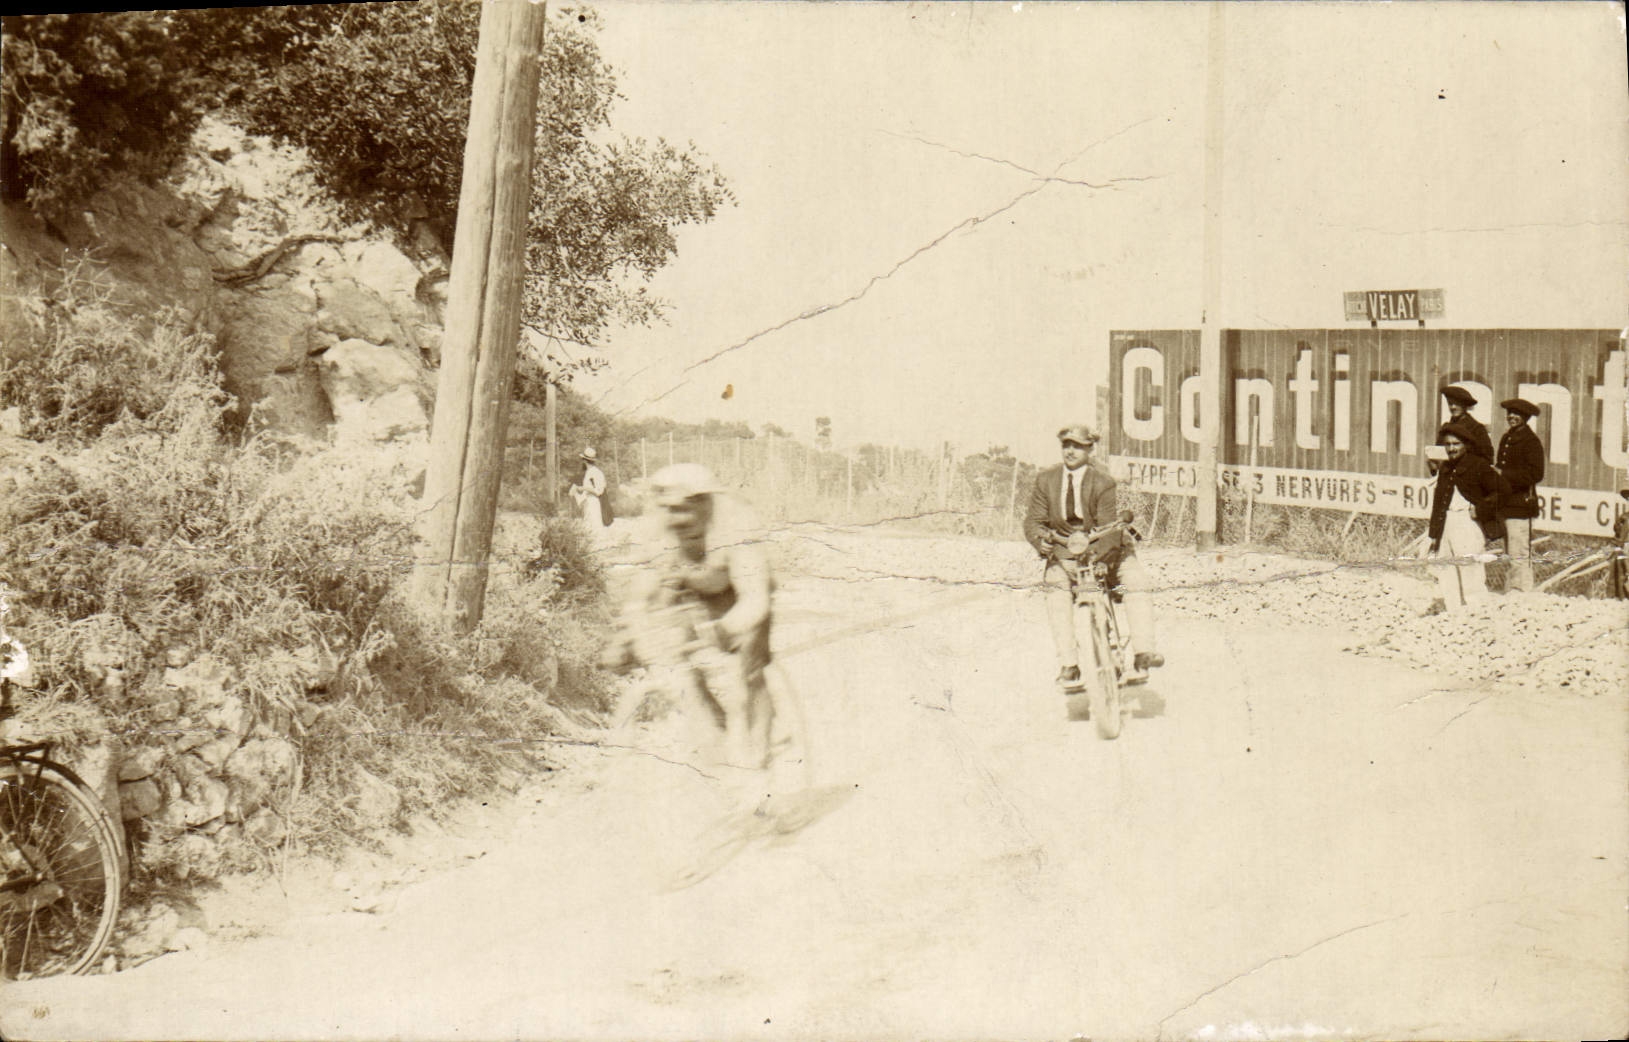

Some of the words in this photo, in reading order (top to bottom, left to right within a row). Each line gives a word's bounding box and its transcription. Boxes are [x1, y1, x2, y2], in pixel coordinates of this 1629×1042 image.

[1369, 293, 1415, 319] VELAY
[1128, 462, 1167, 486] TYPE
[1275, 474, 1376, 504] NERVURES
